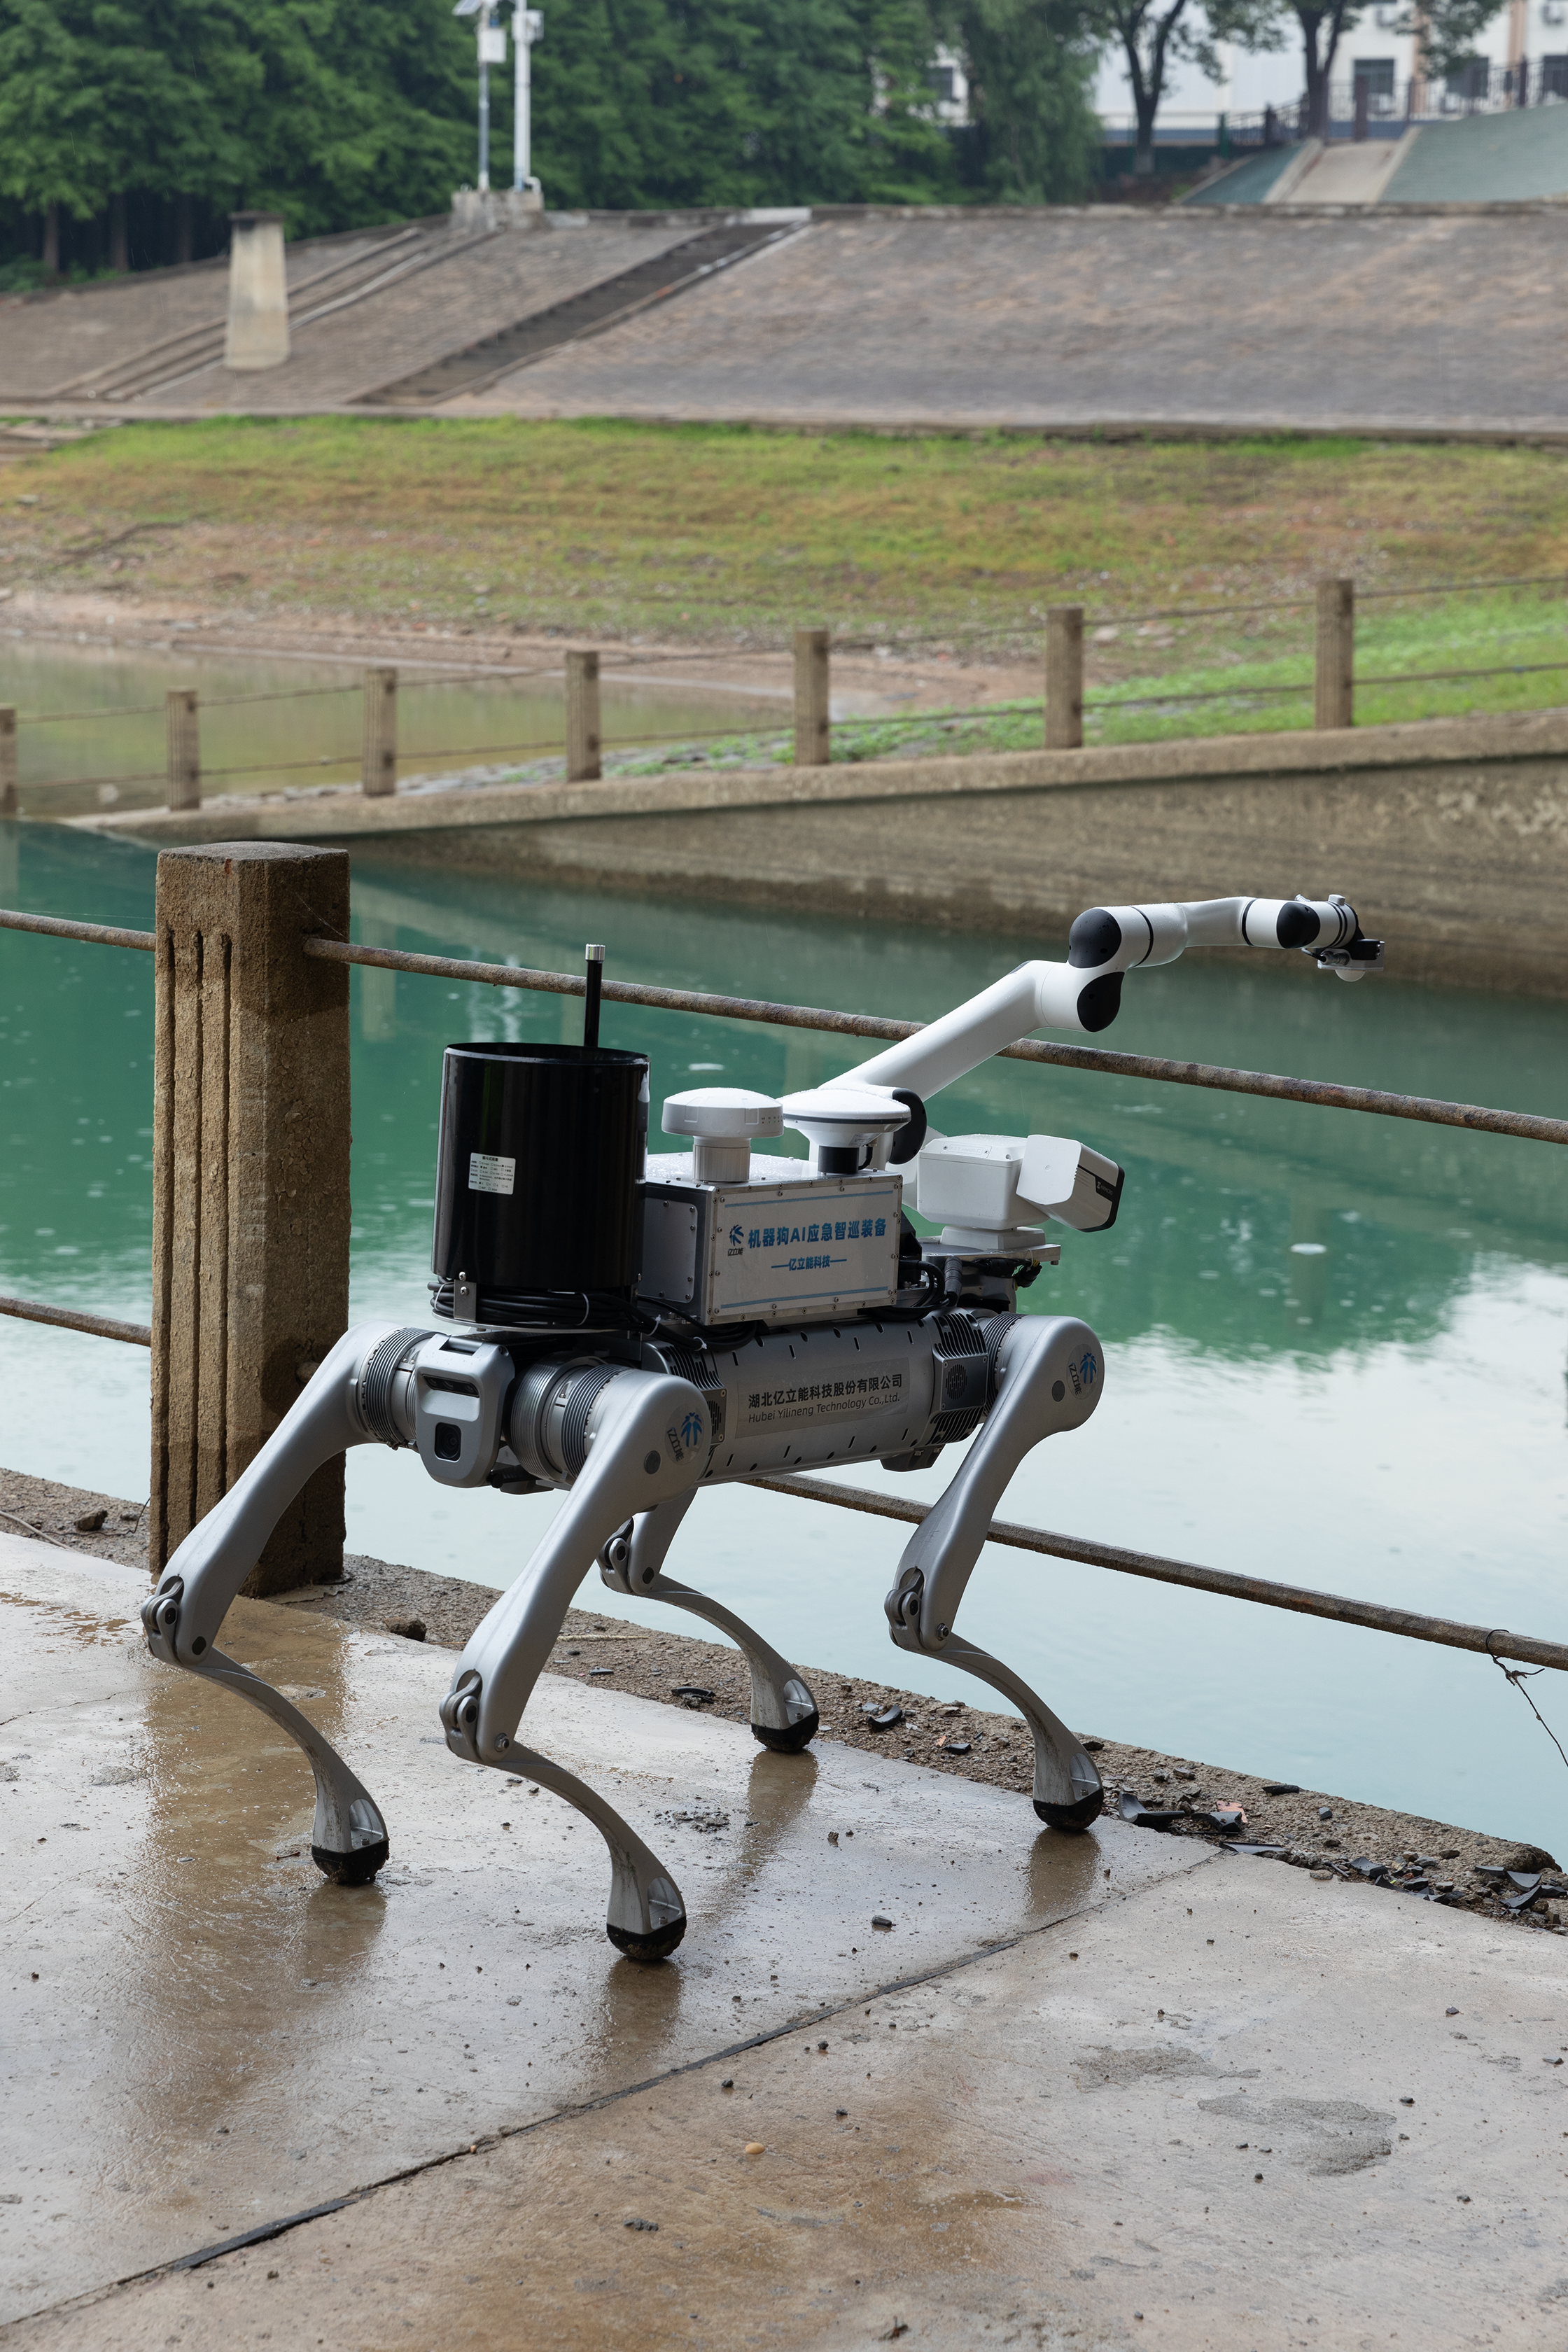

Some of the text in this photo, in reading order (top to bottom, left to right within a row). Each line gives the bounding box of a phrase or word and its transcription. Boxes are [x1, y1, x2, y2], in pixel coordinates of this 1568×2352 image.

[748, 1218, 886, 1249] 机器狗AI应急智巡装备
[748, 1373, 902, 1408] 湖北亿立能科技股份有限公司
[748, 1409, 776, 1423] Hubei
[778, 1406, 813, 1419] Yilineng
[816, 1398, 867, 1413] Technology
